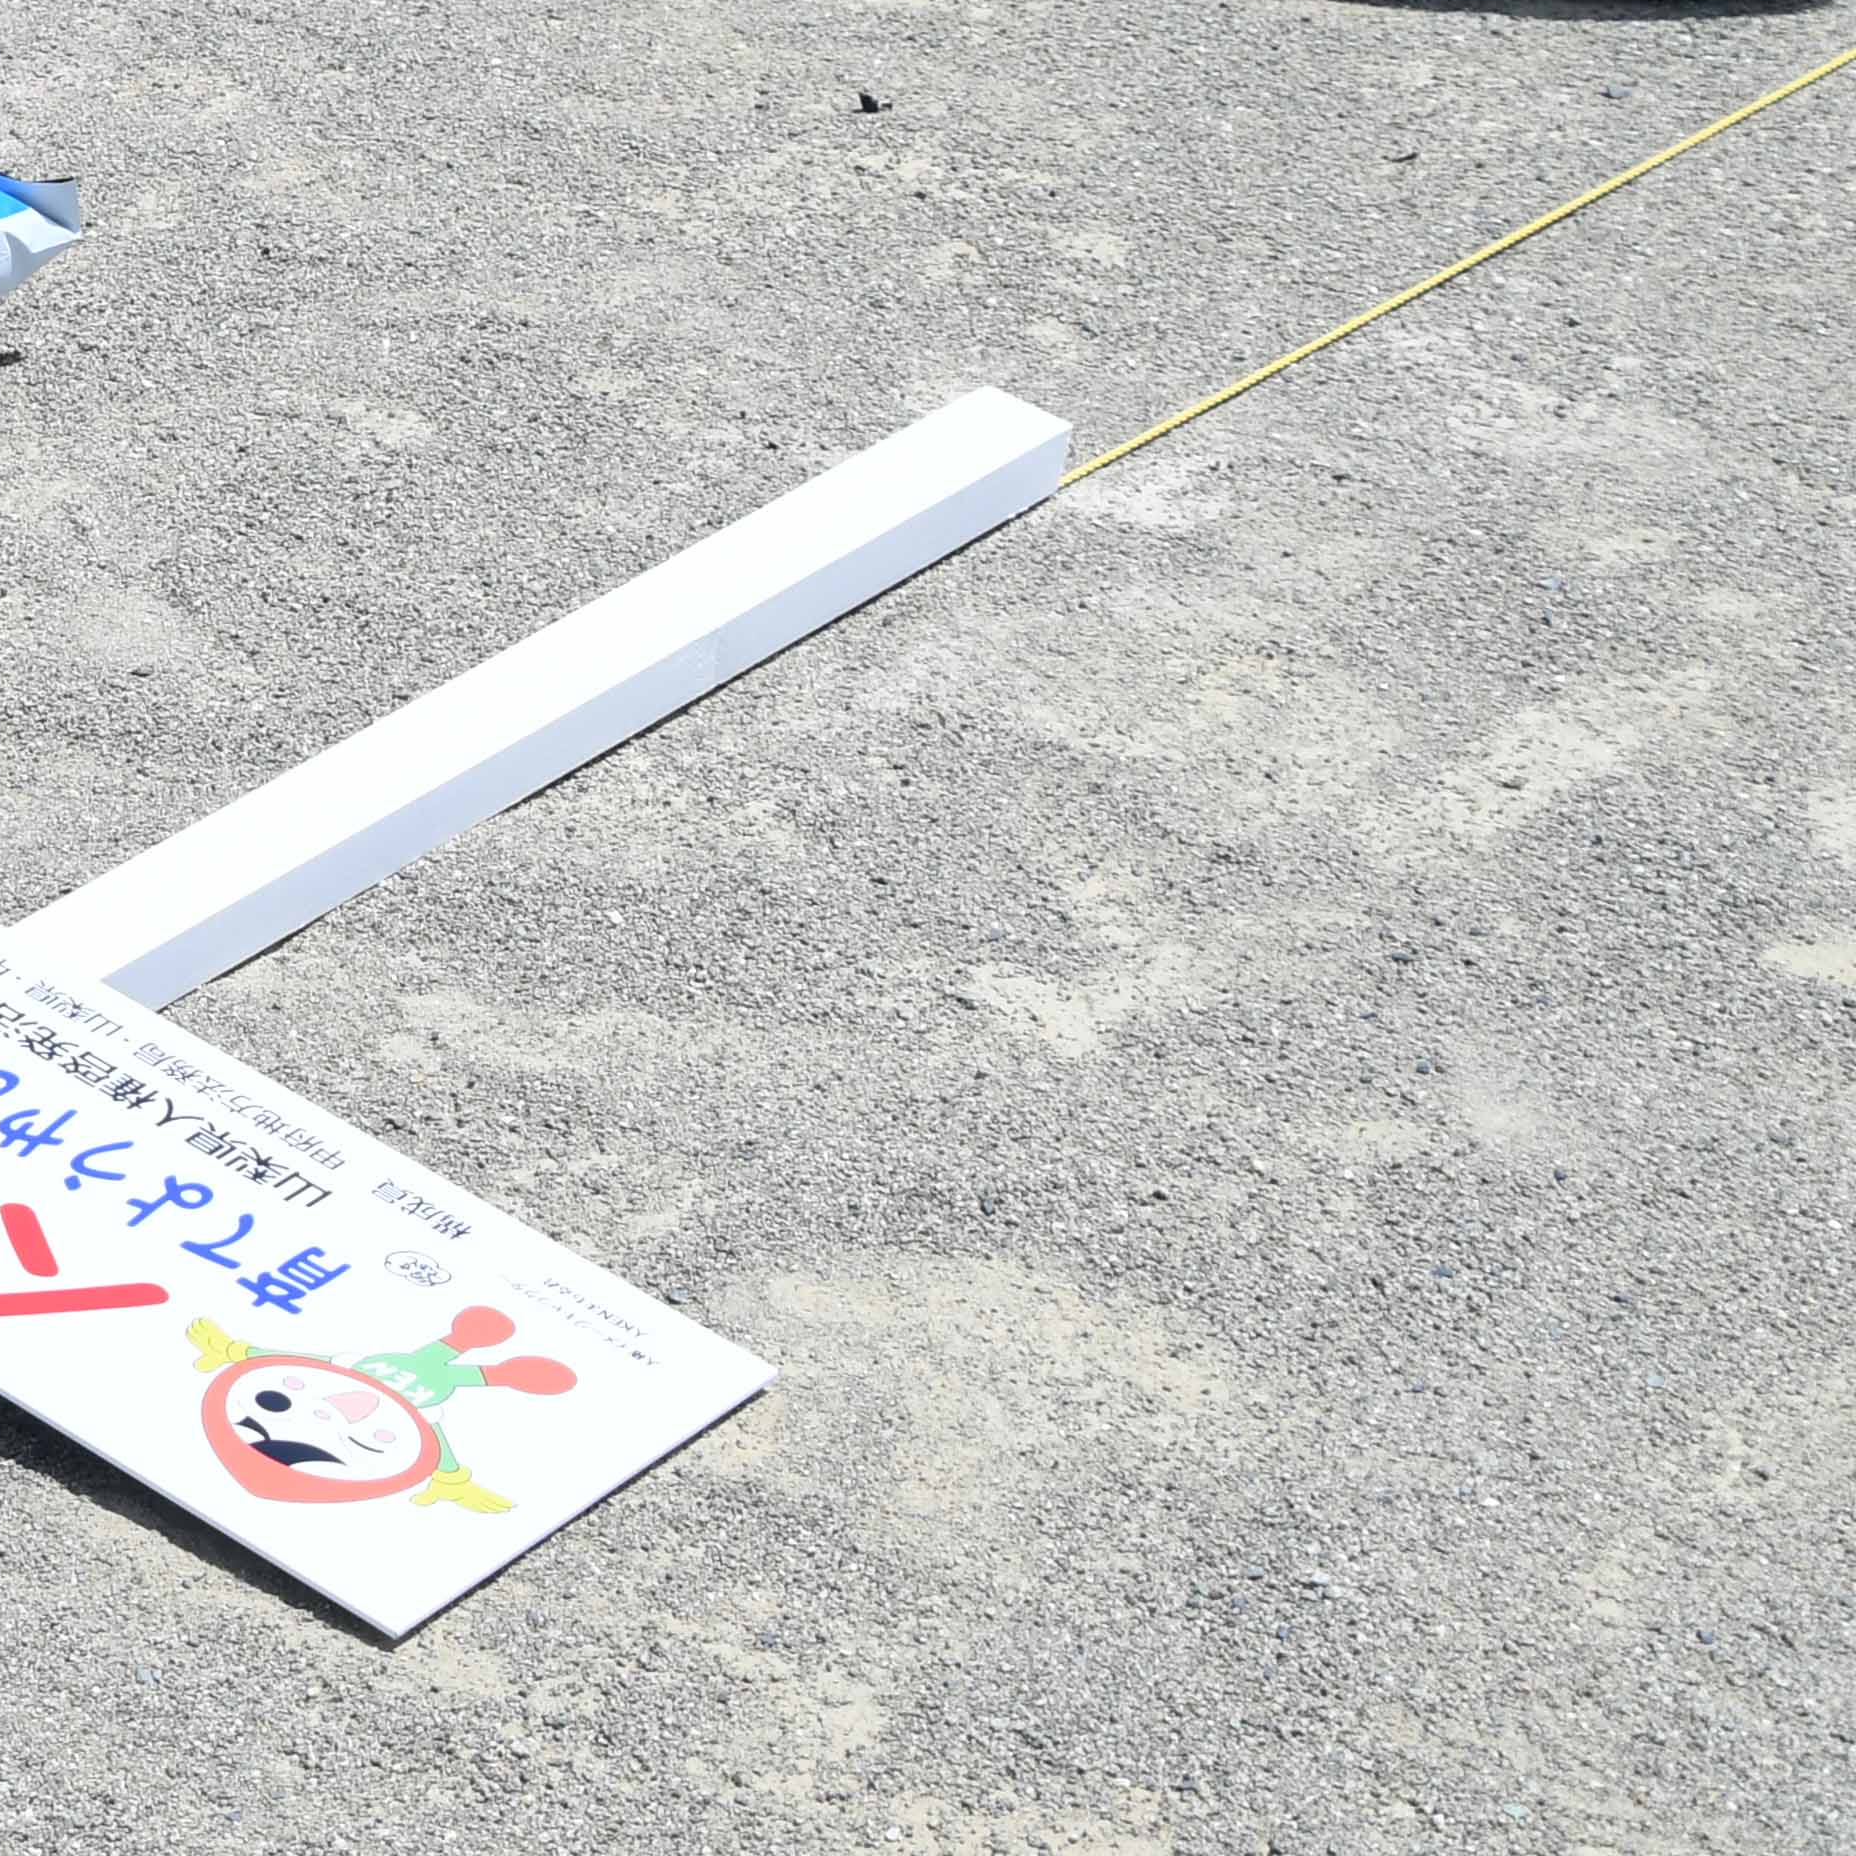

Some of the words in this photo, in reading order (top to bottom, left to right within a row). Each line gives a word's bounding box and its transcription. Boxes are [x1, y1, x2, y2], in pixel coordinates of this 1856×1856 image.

[370, 1177, 472, 1240] 構成員
[362, 1359, 435, 1404] KEN
